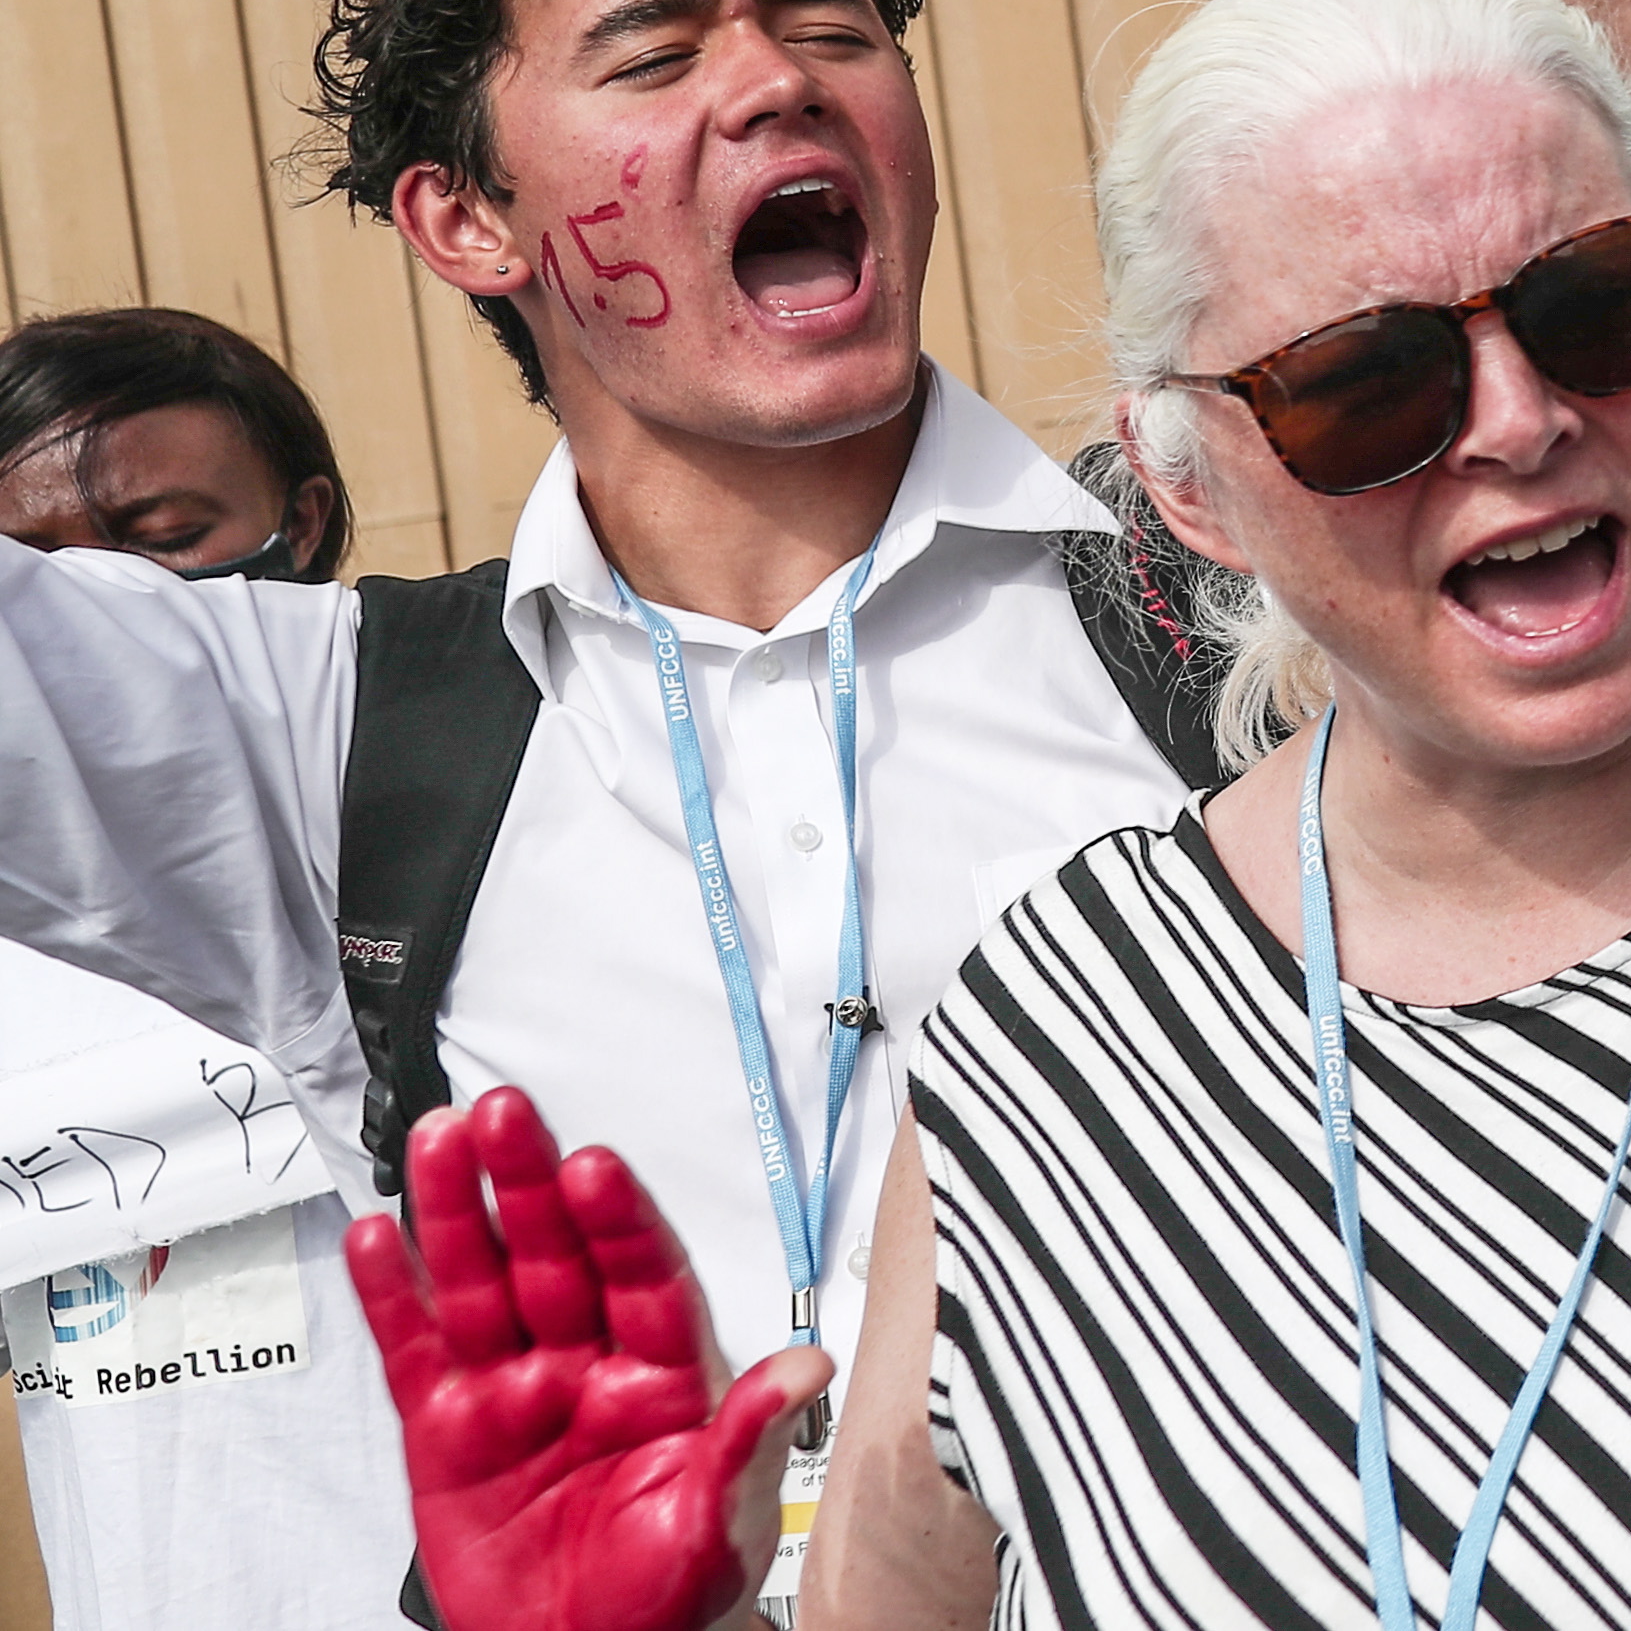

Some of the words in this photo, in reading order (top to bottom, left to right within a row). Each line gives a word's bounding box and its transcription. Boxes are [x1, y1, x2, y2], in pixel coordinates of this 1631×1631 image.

[651, 627, 689, 721] UNFCCC
[832, 593, 852, 696] unfccc.int
[699, 840, 736, 951] unfccc.int
[749, 1075, 786, 1181] UNFCCC
[1320, 1015, 1352, 1145] unfccc.int
[97, 1341, 297, 1395] Rebellion
